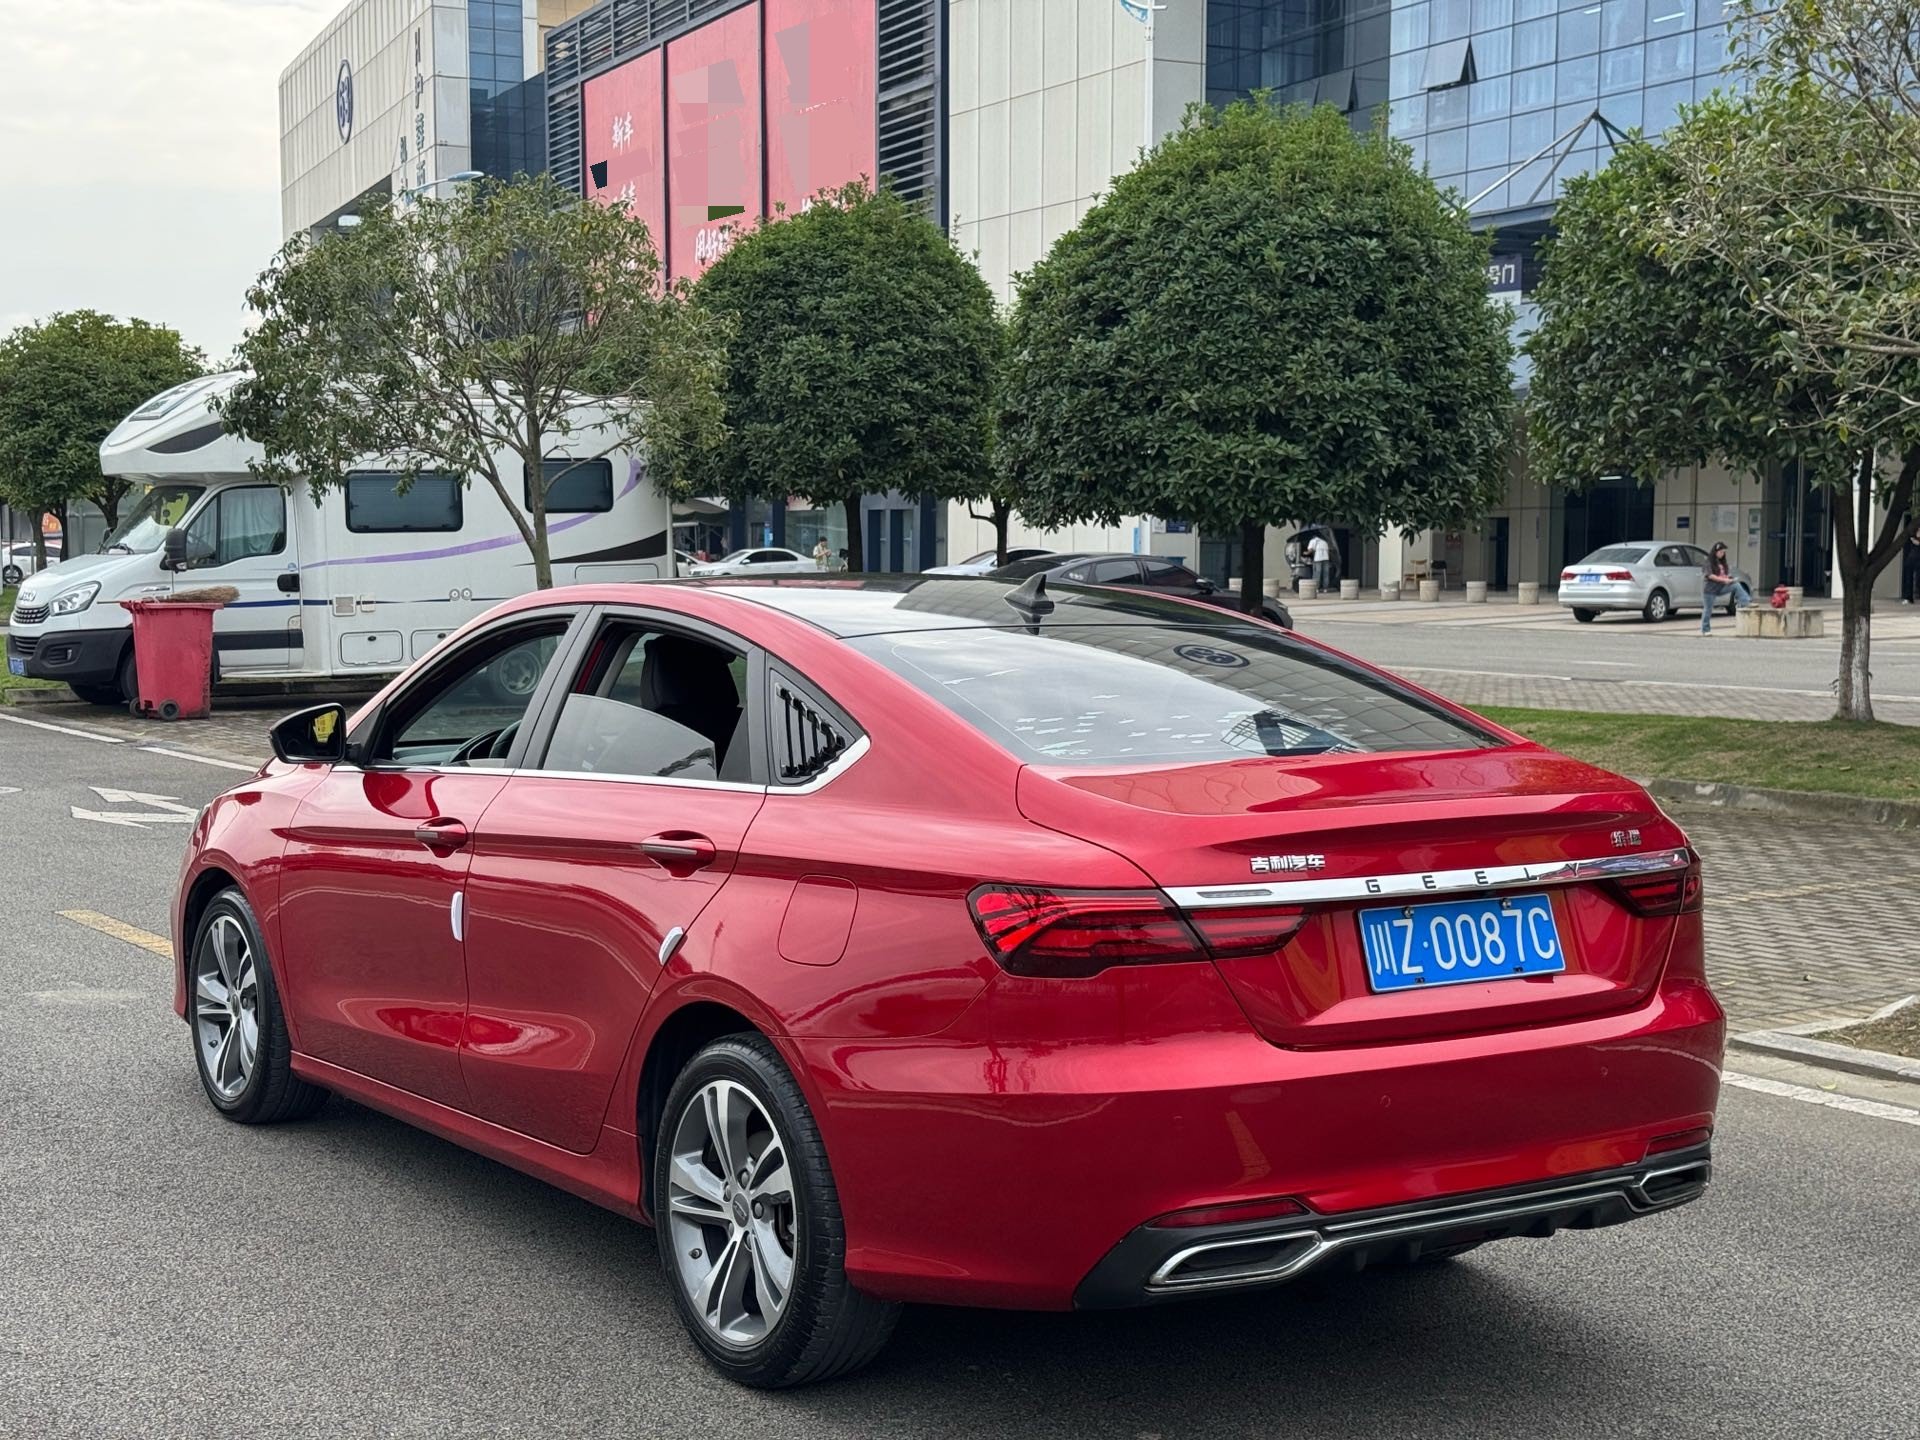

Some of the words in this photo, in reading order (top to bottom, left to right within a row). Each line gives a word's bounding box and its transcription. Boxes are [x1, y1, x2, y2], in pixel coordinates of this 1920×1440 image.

[1250, 854, 1326, 873] 吉利汽车
[1365, 862, 1580, 894] GEELY
